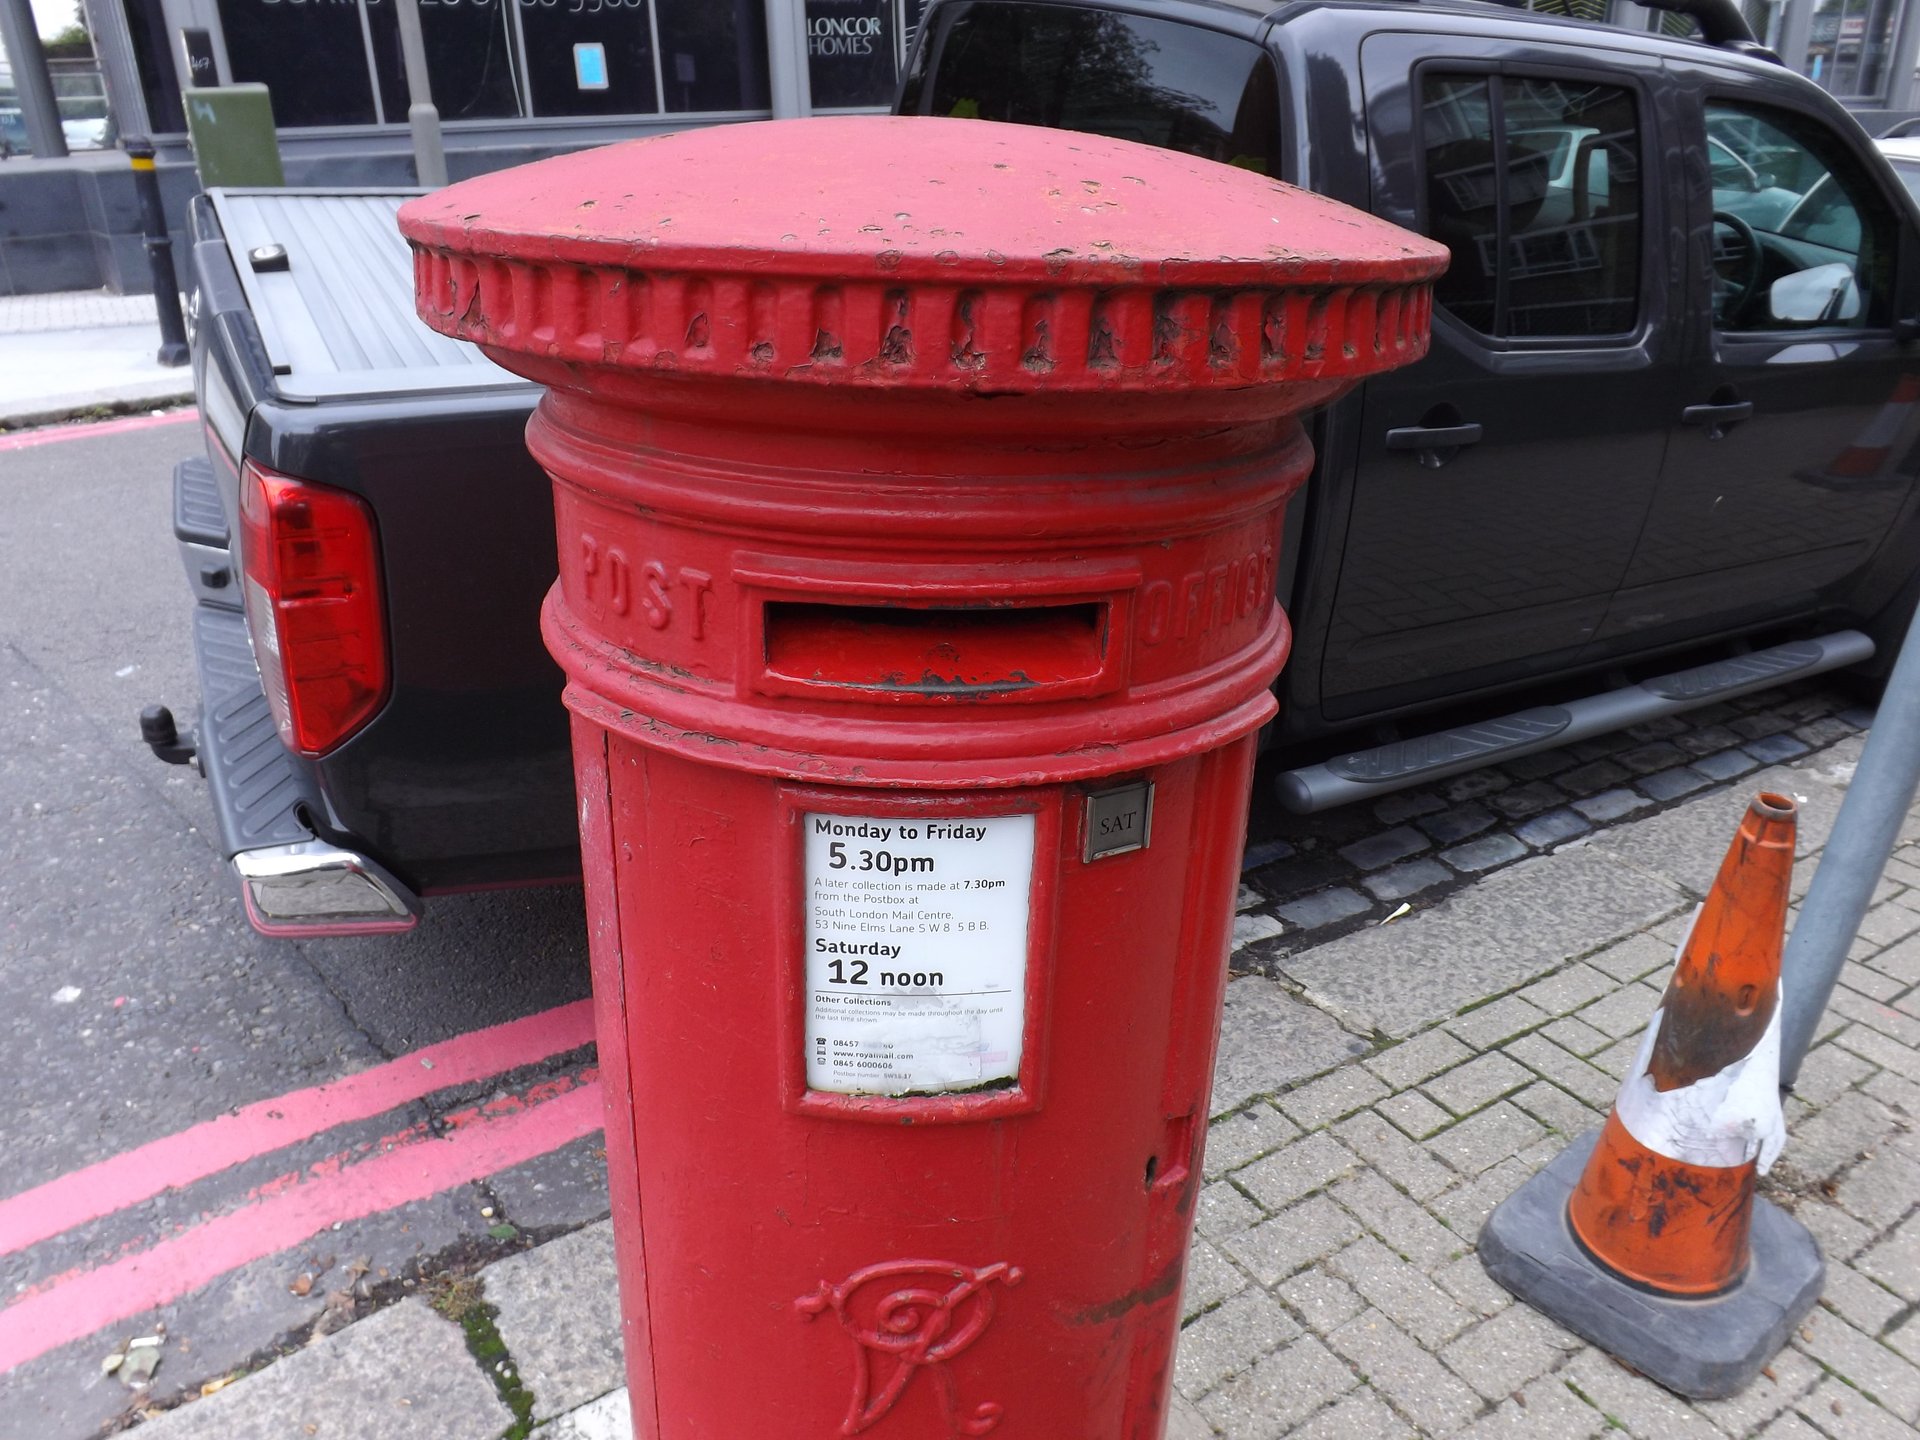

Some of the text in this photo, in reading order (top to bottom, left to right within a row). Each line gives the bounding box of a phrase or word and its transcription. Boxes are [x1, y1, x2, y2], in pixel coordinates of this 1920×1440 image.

[807, 17, 882, 36] LONCOR
[808, 36, 873, 55] HOMES
[580, 532, 713, 641] POST
[815, 818, 987, 842] Monday to Friday
[1100, 810, 1137, 836] SAT
[828, 841, 935, 877] 5.30pm
[814, 877, 1006, 892] A later collection is made at 7.30pm
[814, 890, 919, 905] from the Postbox at
[815, 906, 846, 918] South
[849, 908, 889, 920] London
[892, 910, 914, 920] Mail
[815, 920, 829, 930] 53
[833, 921, 857, 932] Nine
[861, 922, 886, 933] Elms
[890, 923, 915, 934] Lane
[815, 938, 902, 959] Saturday
[828, 959, 944, 987] 12 noon
[815, 995, 892, 1006] Other Collections
[815, 1006, 847, 1014] Additional
[848, 1008, 881, 1016] collections
[883, 1010, 896, 1018] may
[976, 1007, 987, 1016] day
[815, 1013, 826, 1021] the
[827, 1014, 839, 1022] last
[833, 1040, 859, 1049] 08457
[833, 1050, 914, 1060] www.royalmail.com
[833, 1059, 893, 1070] 0845 6000606
[833, 1070, 856, 1078] Postbox
[857, 1071, 880, 1079] number
